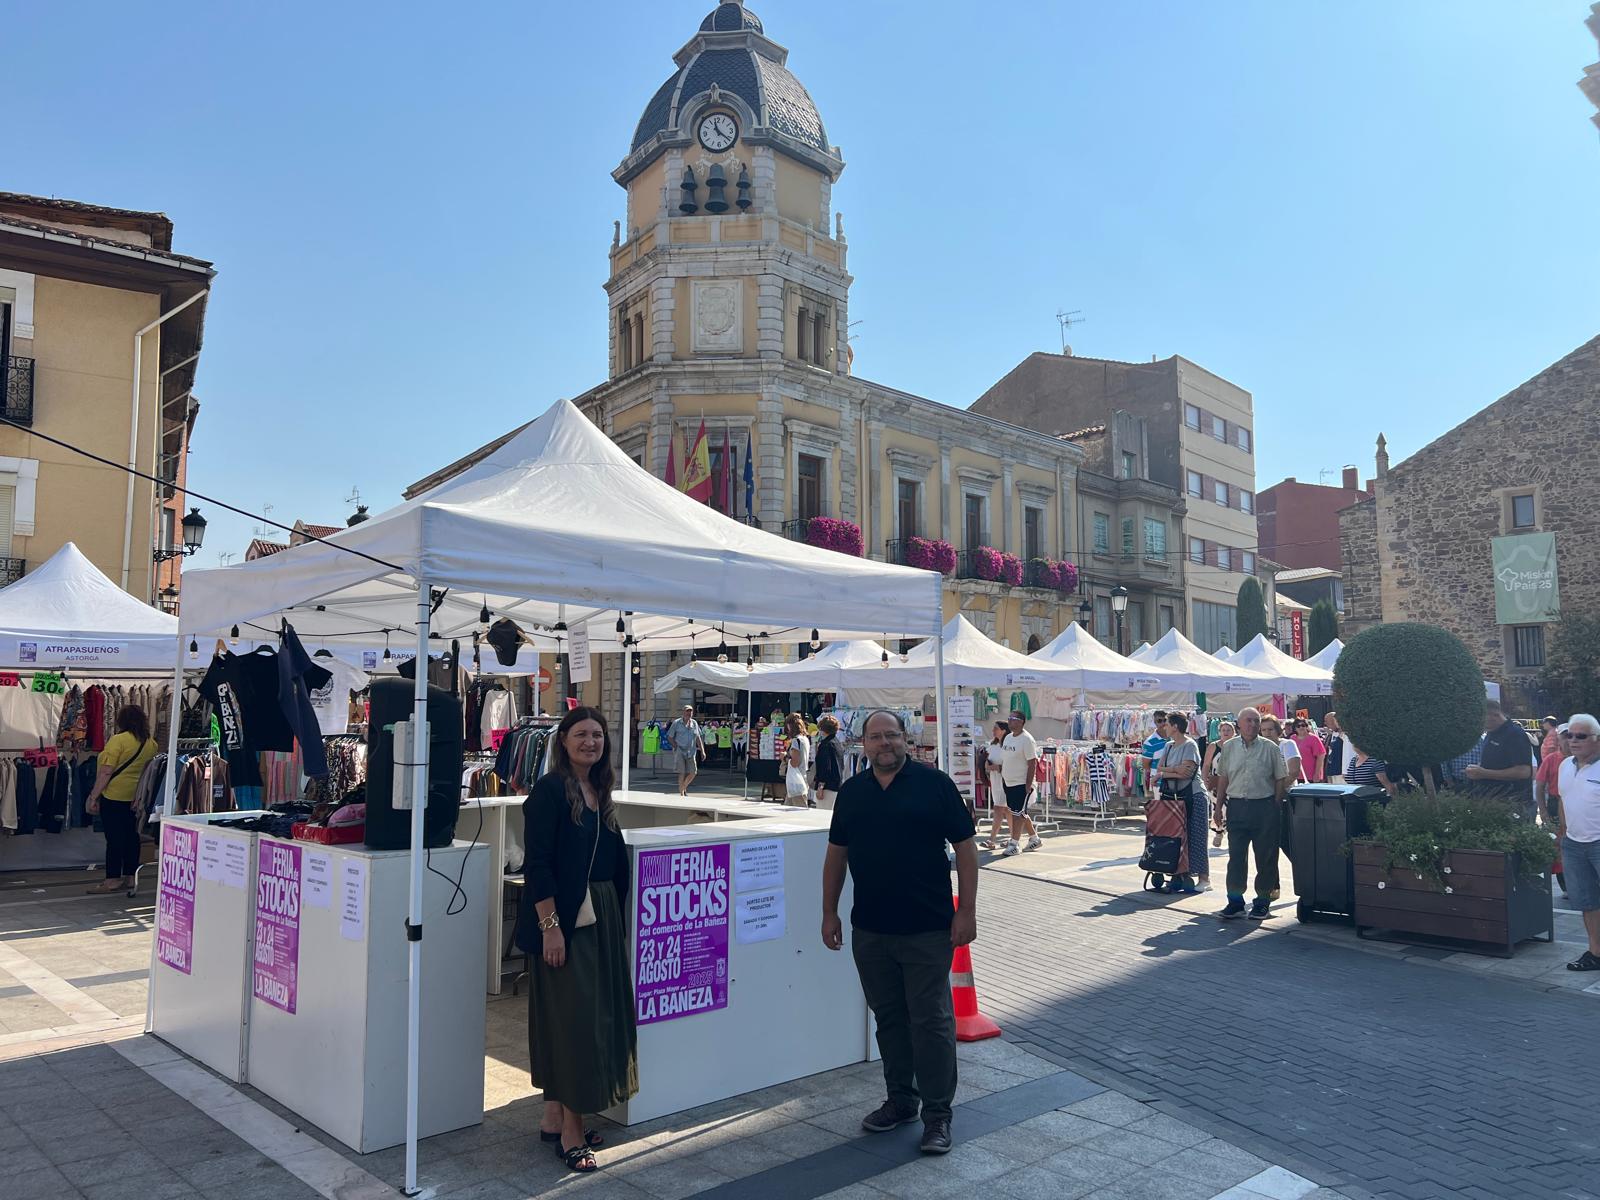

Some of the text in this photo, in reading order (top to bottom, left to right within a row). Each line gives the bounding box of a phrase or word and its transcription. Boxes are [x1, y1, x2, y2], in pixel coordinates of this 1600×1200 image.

[1538, 580, 1552, 588] 25
[45, 645, 120, 654] ATRAPASUEÑOS
[174, 830, 192, 857] FERIA
[162, 853, 195, 893] STOCKS
[272, 846, 294, 878] FERIA
[671, 850, 715, 884] FERIA
[716, 866, 726, 878] de
[258, 873, 298, 918] STOCKS
[641, 879, 727, 926] STOCKS
[640, 917, 727, 937] del comercio de La Bañeza
[158, 940, 165, 959] LA
[640, 939, 655, 963] 23
[658, 942, 664, 959] Y
[666, 935, 680, 958] 24
[639, 956, 681, 985] AGOSTO
[688, 971, 714, 988] 2025
[255, 974, 288, 1007] LA BAÑEZA
[638, 985, 714, 1021] LA BAÑEZA
